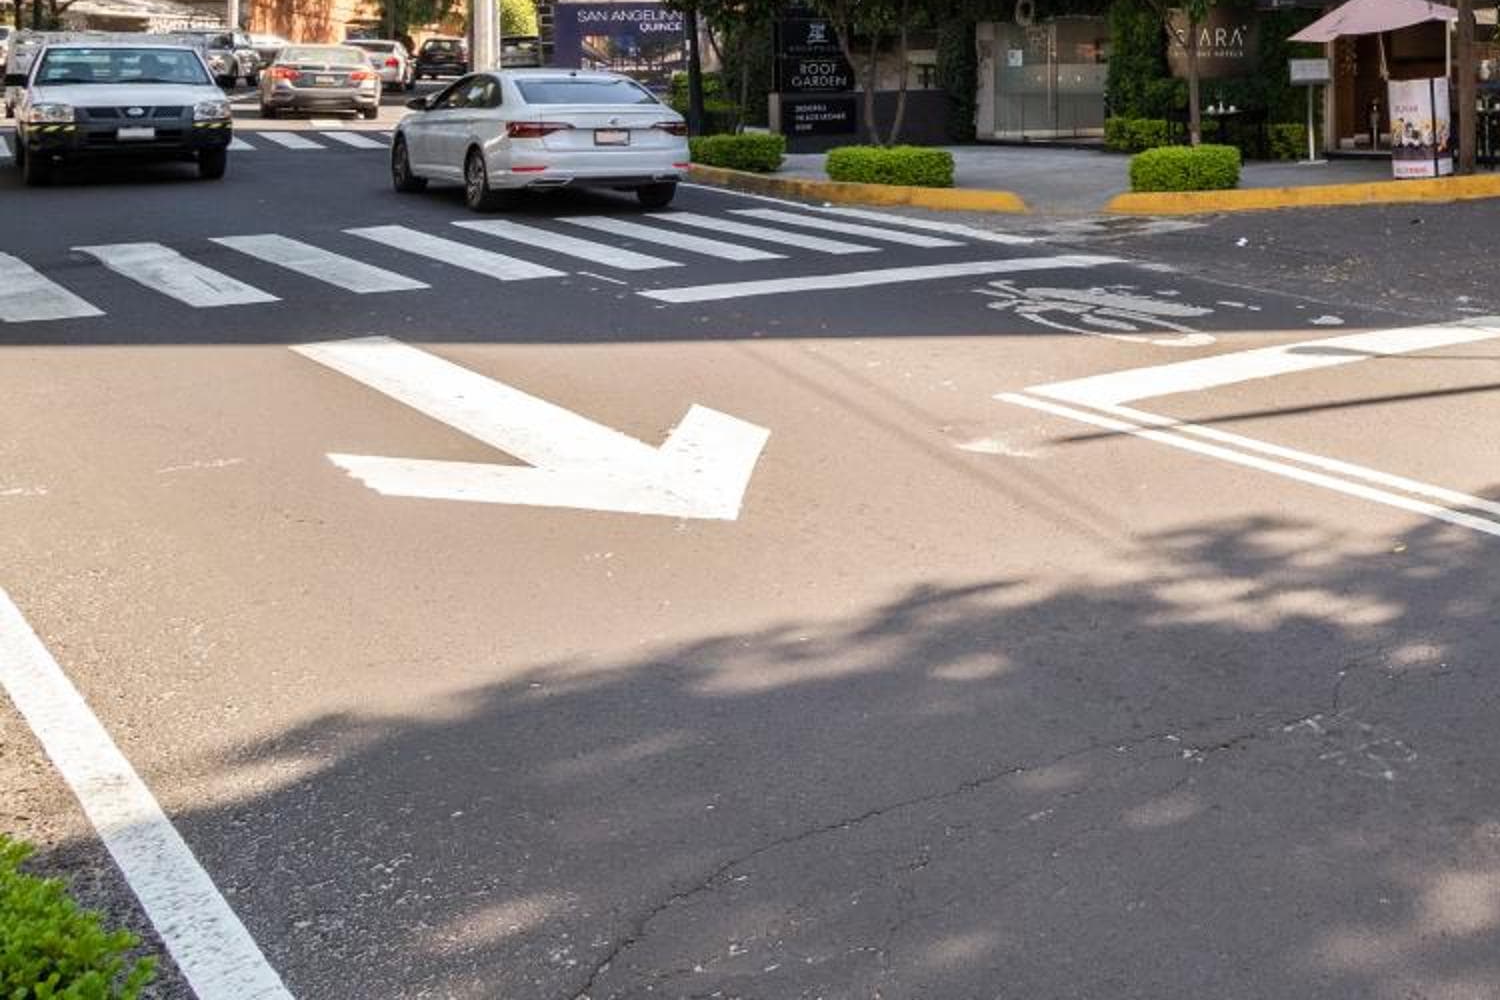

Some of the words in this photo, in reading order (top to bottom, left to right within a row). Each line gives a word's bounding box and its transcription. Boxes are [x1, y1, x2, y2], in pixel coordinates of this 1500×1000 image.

[577, 9, 608, 22] SAN
[639, 22, 683, 32] QUINCE
[1175, 27, 1244, 47] SARA
[791, 75, 847, 87] GARDEN
